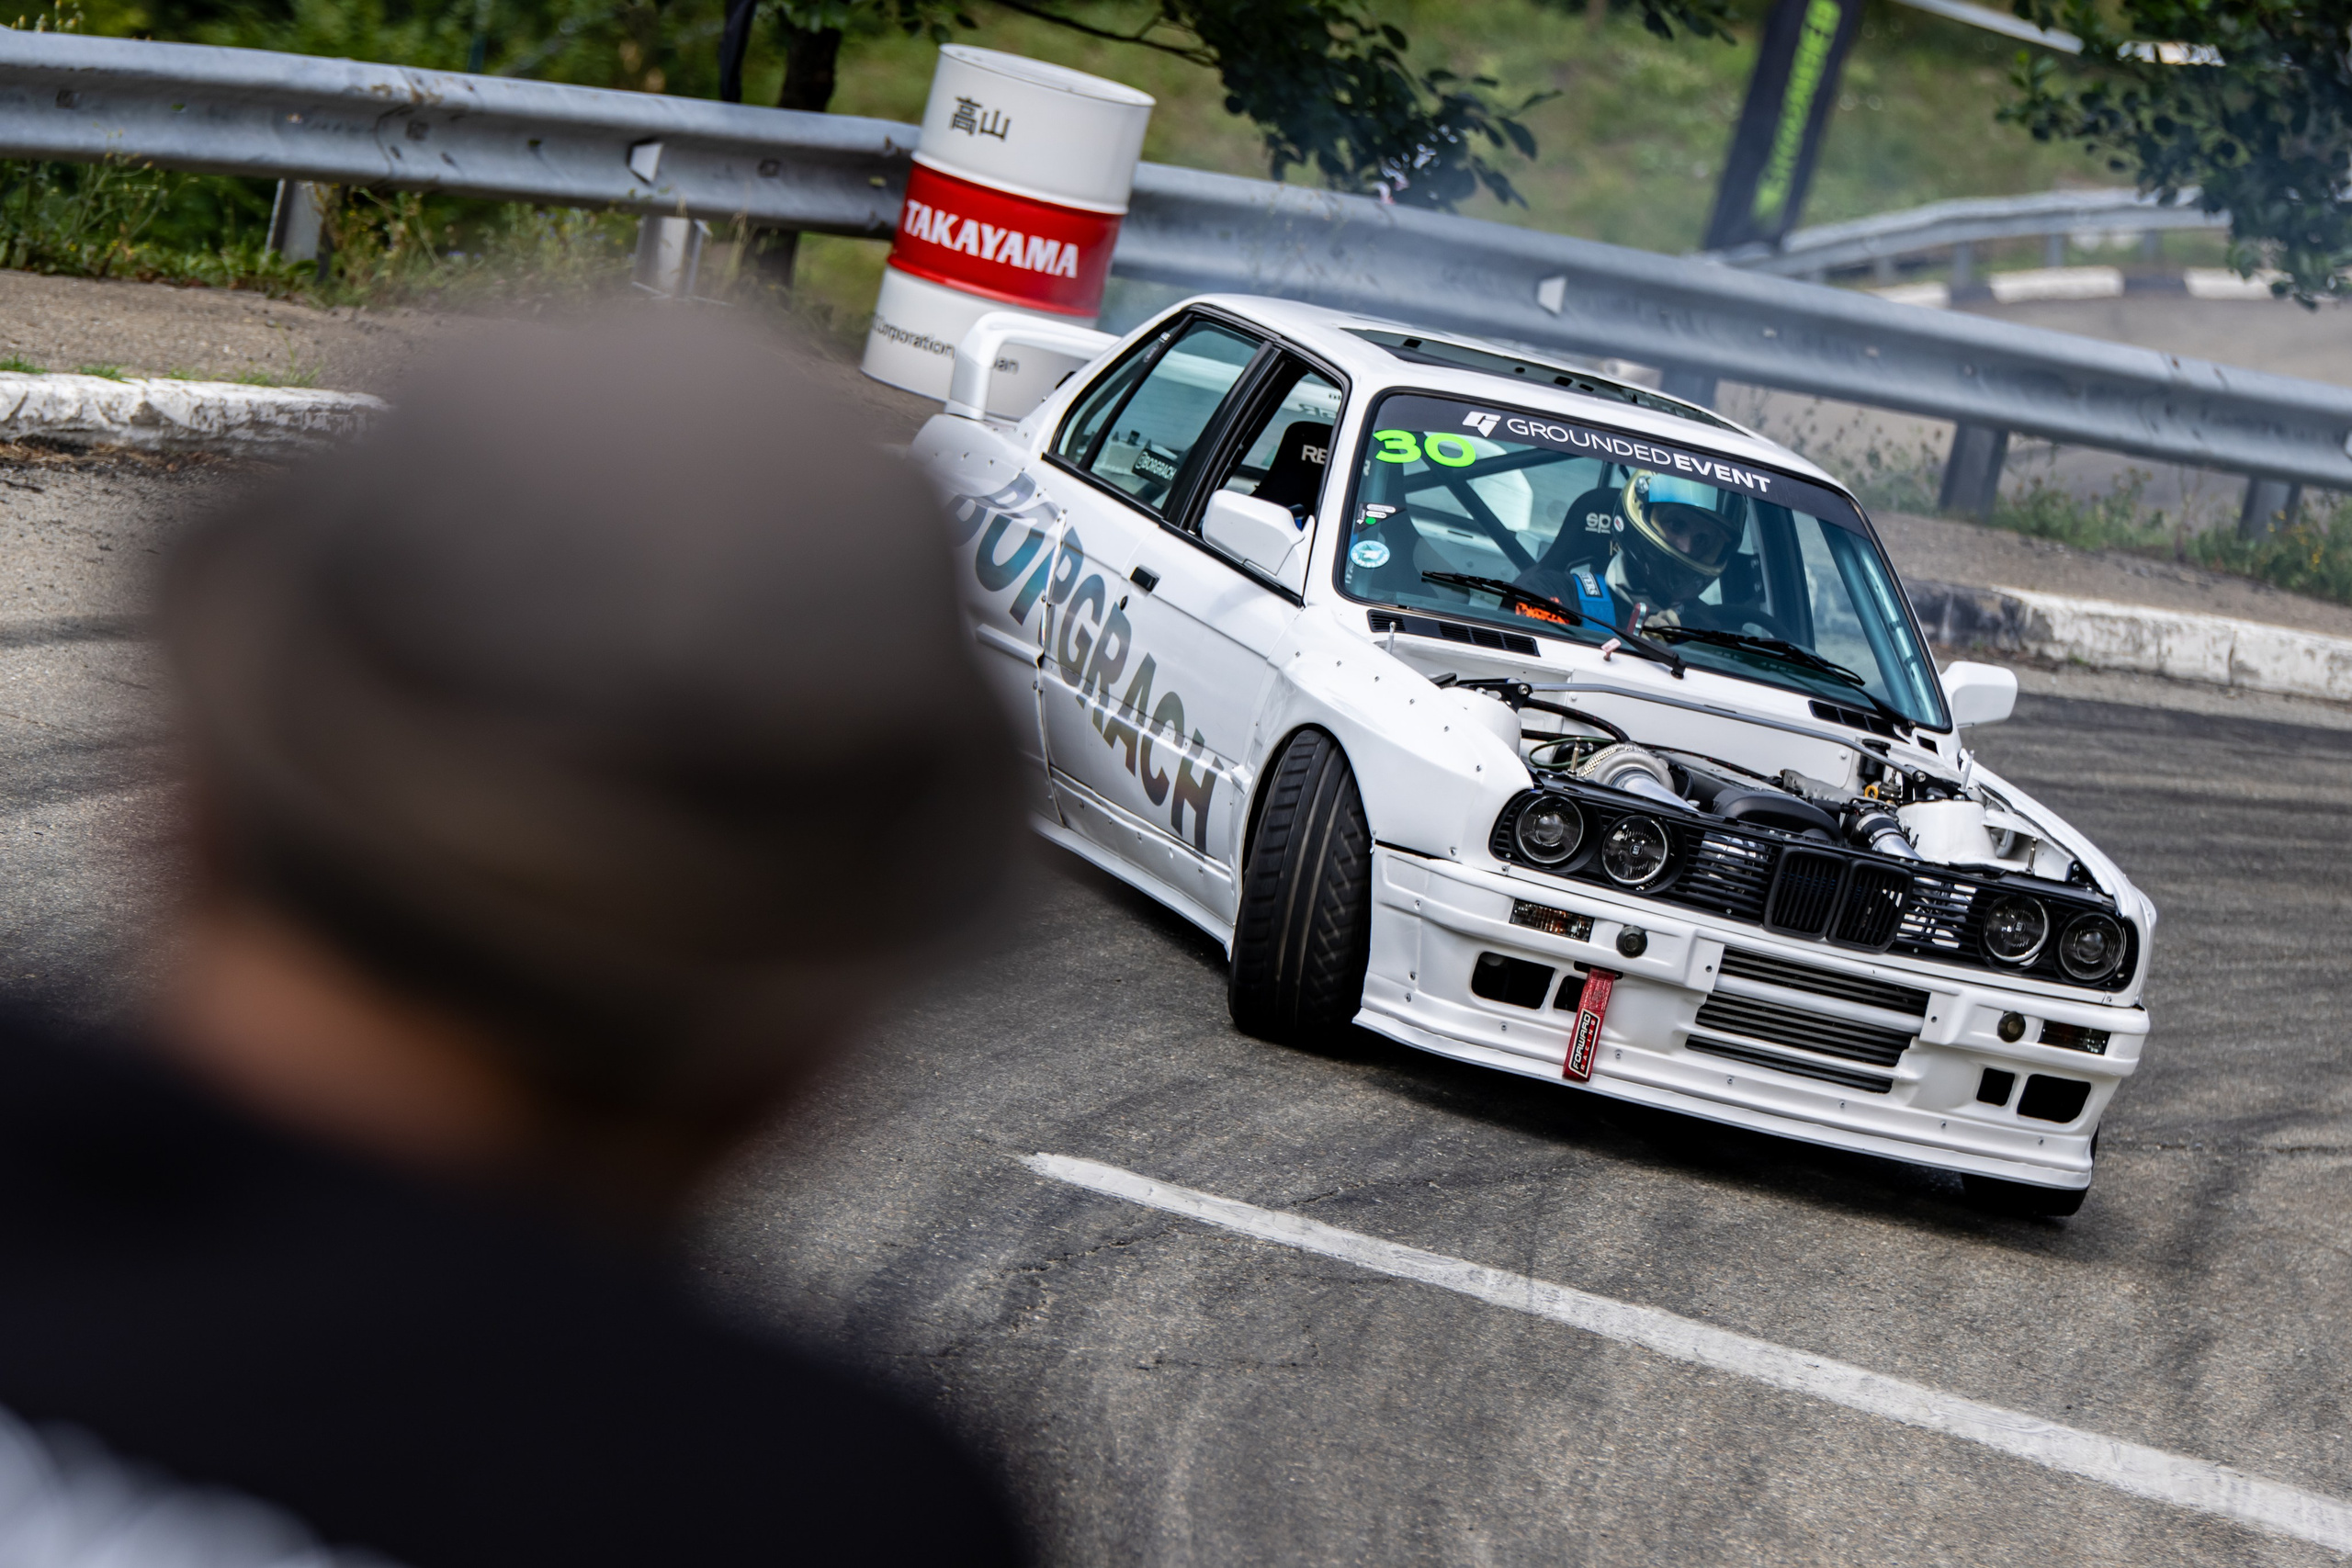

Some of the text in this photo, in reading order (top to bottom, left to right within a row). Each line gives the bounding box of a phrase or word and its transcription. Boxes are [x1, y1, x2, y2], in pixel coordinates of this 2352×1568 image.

[949, 96, 1011, 141] 高山
[904, 199, 1079, 278] TAKAYAMA
[1374, 429, 1476, 468] 30
[1572, 1013, 1591, 1069] FORWARD
[1580, 1019, 1596, 1070] RACING
